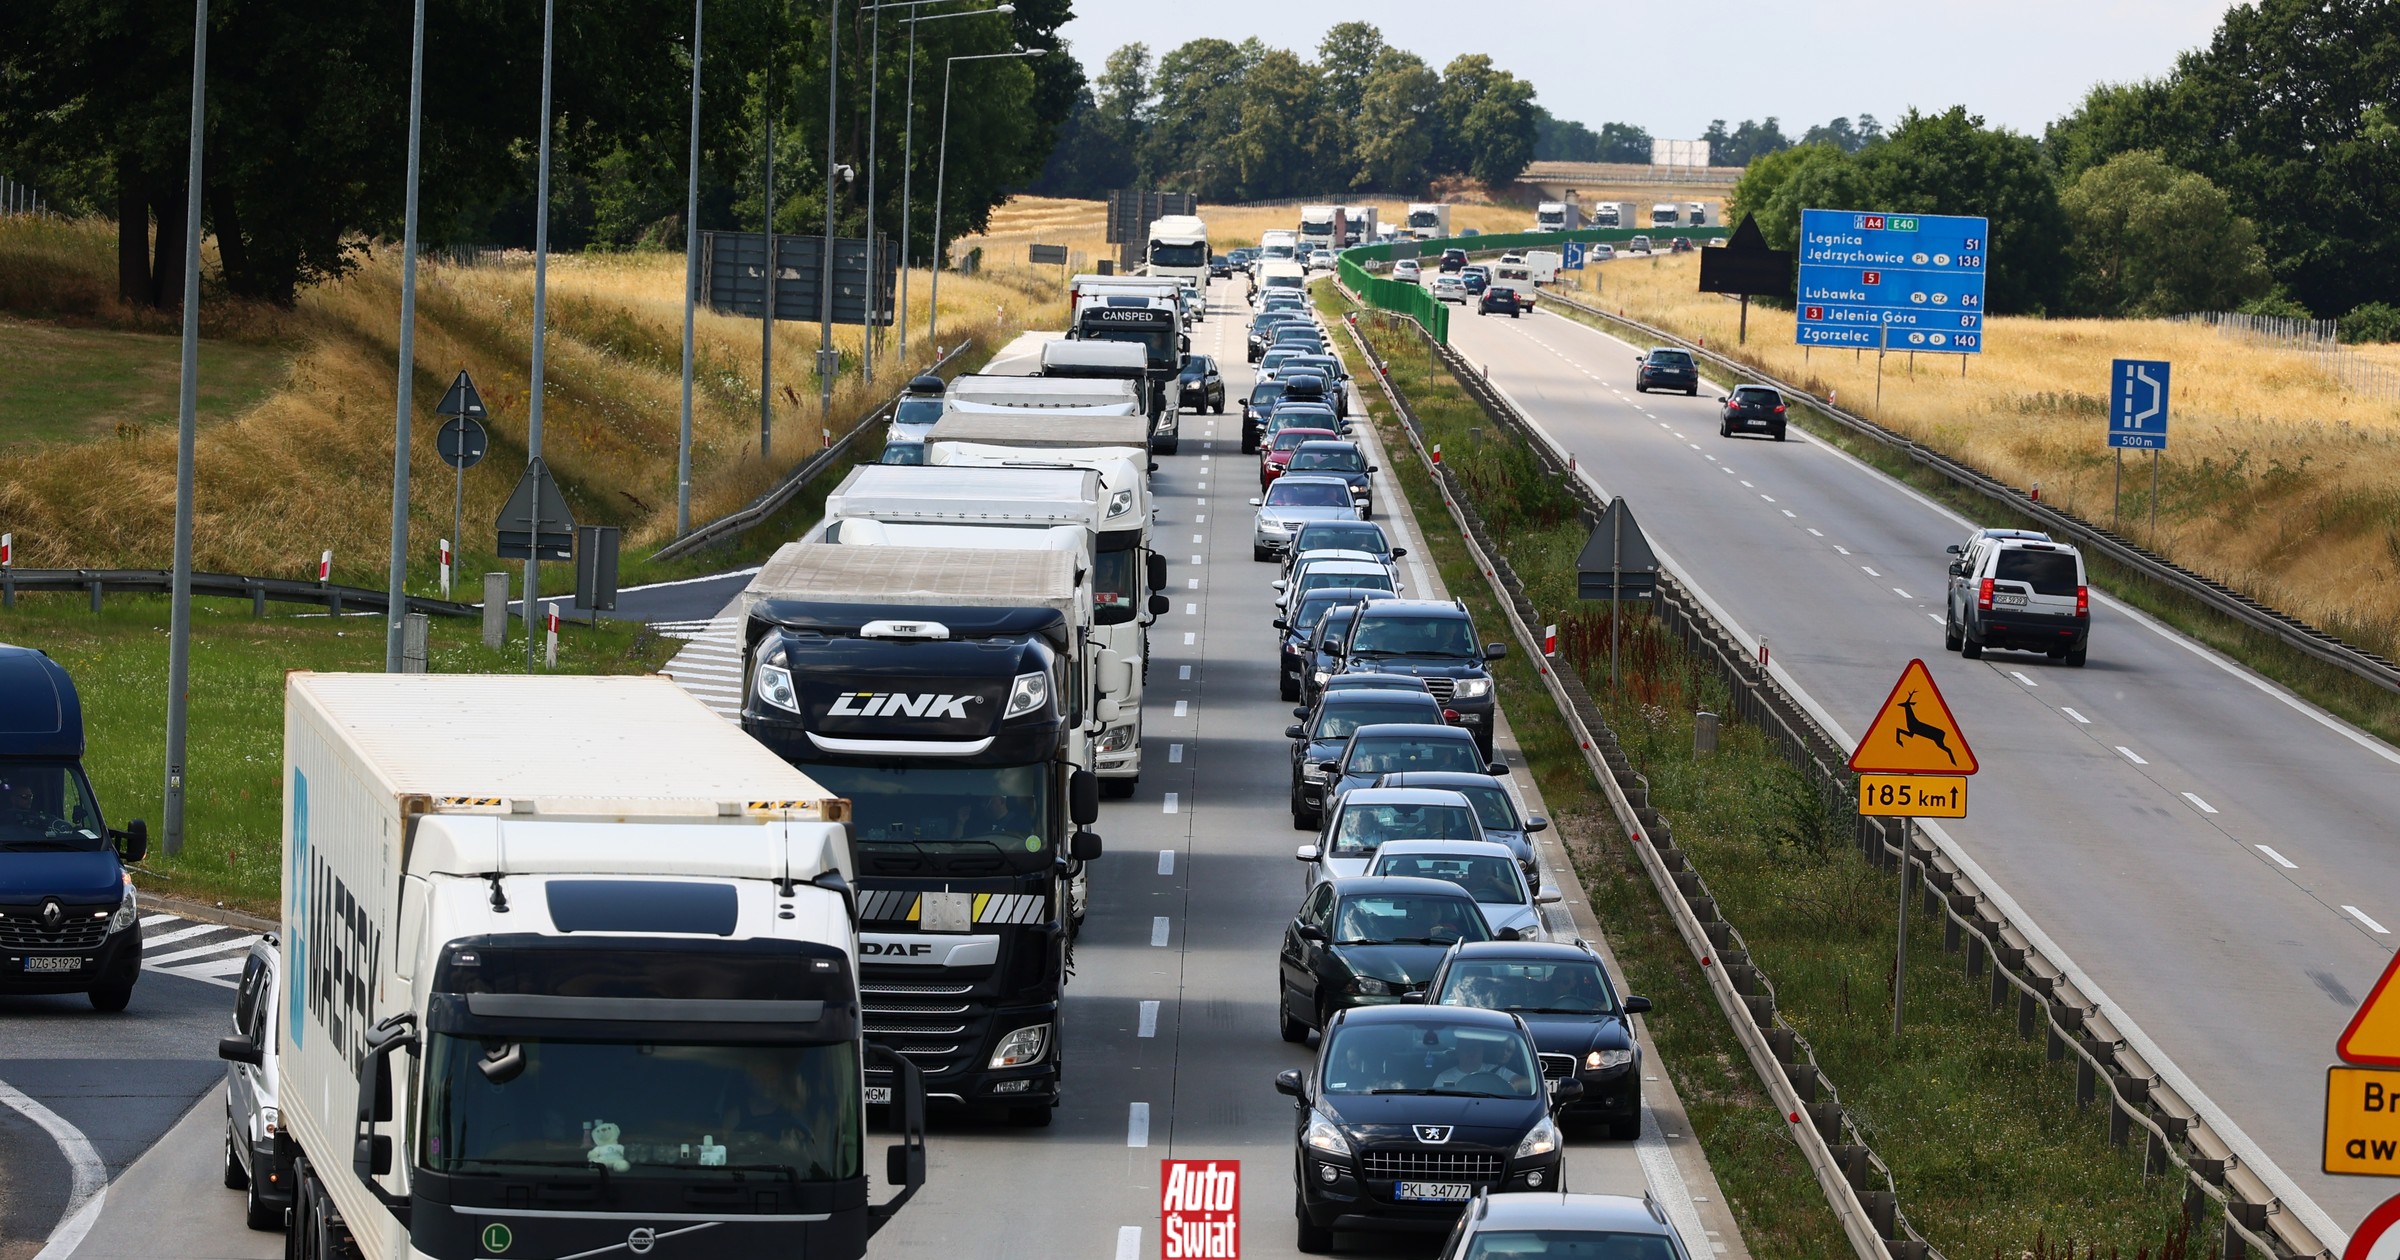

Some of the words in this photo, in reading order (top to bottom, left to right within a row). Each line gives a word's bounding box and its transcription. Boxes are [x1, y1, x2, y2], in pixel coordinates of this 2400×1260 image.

[1867, 218, 1882, 228] A4
[1893, 219, 1914, 230] E40
[1808, 232, 1862, 246] Legnica
[1966, 239, 1979, 250] 51
[1807, 248, 1904, 264] Jędrzychowice
[1958, 256, 1980, 267] 138
[1868, 274, 1875, 283] 5
[1806, 287, 1865, 300] Lubawka
[1933, 294, 1945, 303] CZ
[1961, 295, 1978, 306] 84
[1102, 311, 1153, 321] CANSPED
[1811, 309, 1818, 318] 3
[1828, 309, 1878, 322] Jelenia
[1882, 310, 1917, 325] Góra
[1961, 315, 1977, 327] 87
[1803, 328, 1869, 343] Zgorzelec
[1954, 335, 1976, 347] 140
[2122, 436, 2142, 446] 500
[893, 625, 917, 633] LITE
[1880, 785, 1911, 805] 85
[1918, 789, 1946, 807] km
[860, 943, 931, 956] DAF
[30, 958, 49, 968] DZG
[2346, 1139, 2400, 1160] aw
[1401, 1183, 1426, 1197] PKL
[1430, 1184, 1470, 1198] 34777
[491, 1228, 504, 1248] L
